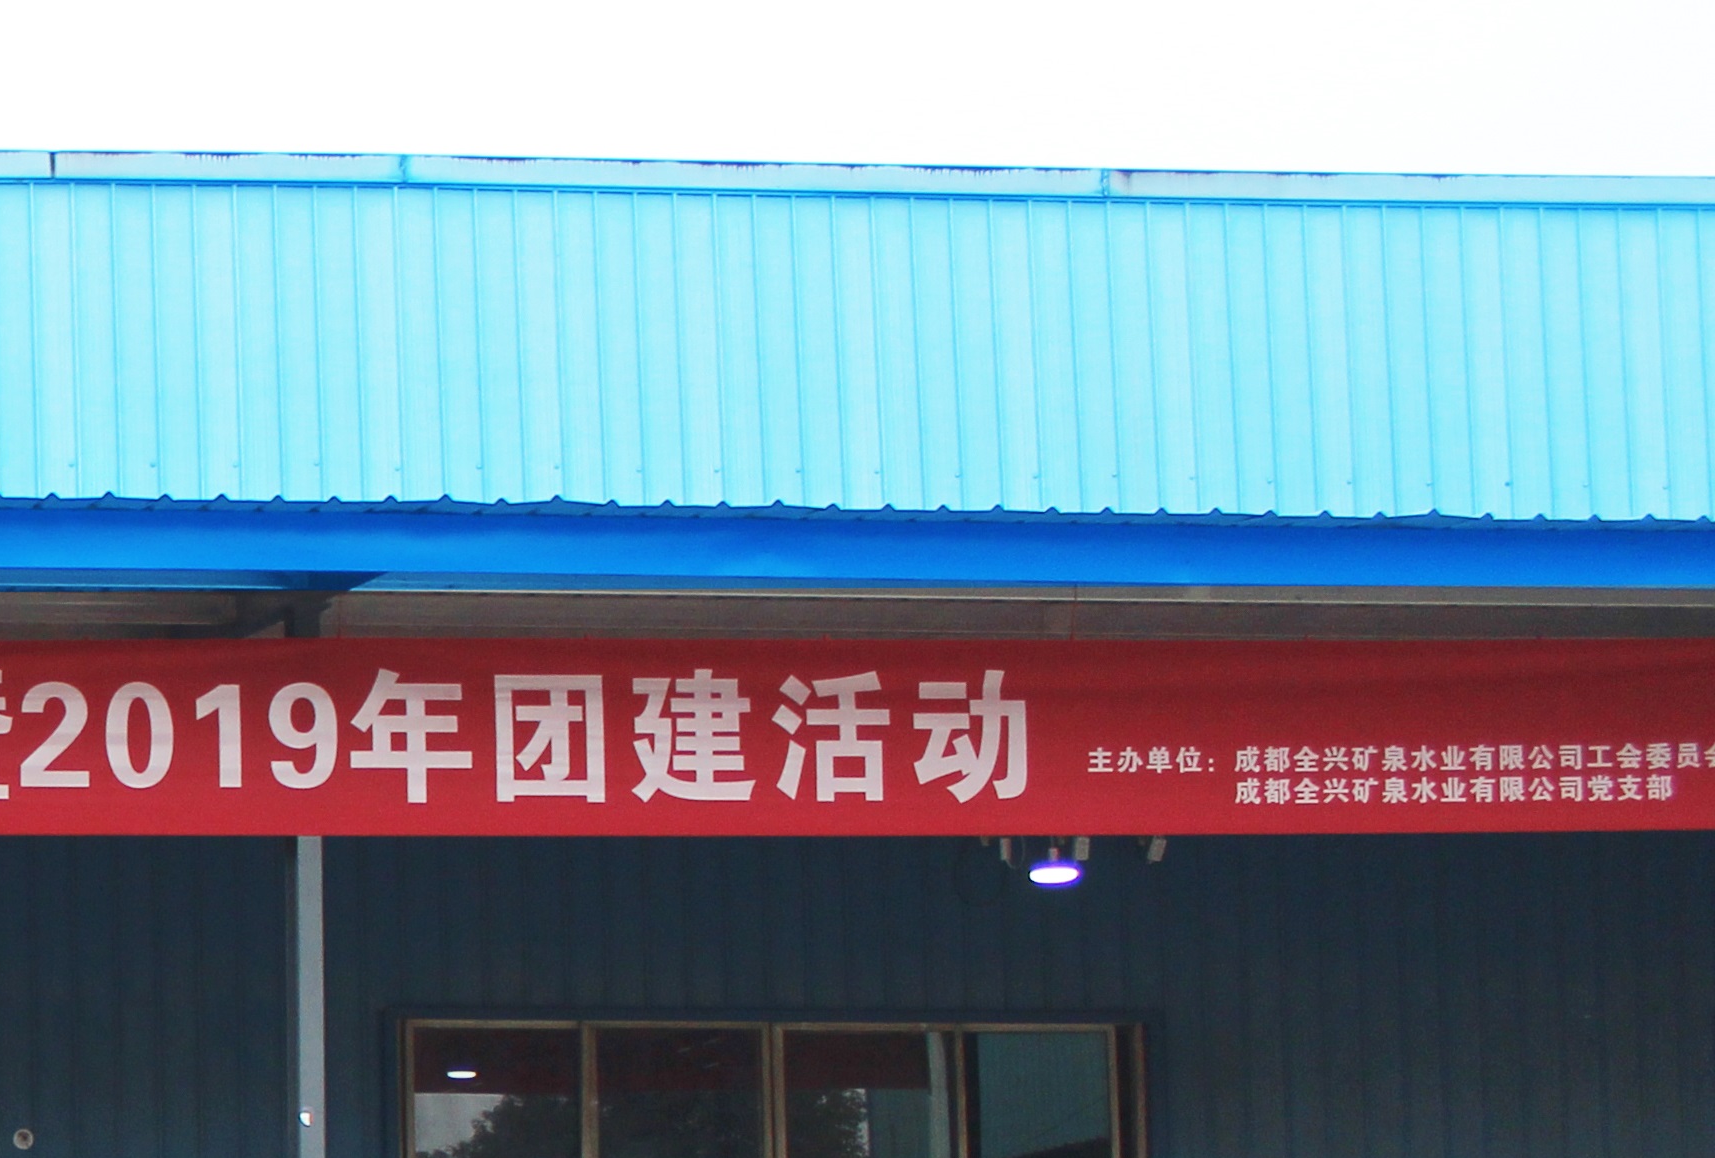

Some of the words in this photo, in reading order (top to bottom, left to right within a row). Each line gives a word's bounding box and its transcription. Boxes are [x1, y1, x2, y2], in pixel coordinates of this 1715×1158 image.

[1234, 773, 1674, 804] 成都全兴矿泉水业有限公司党支部
